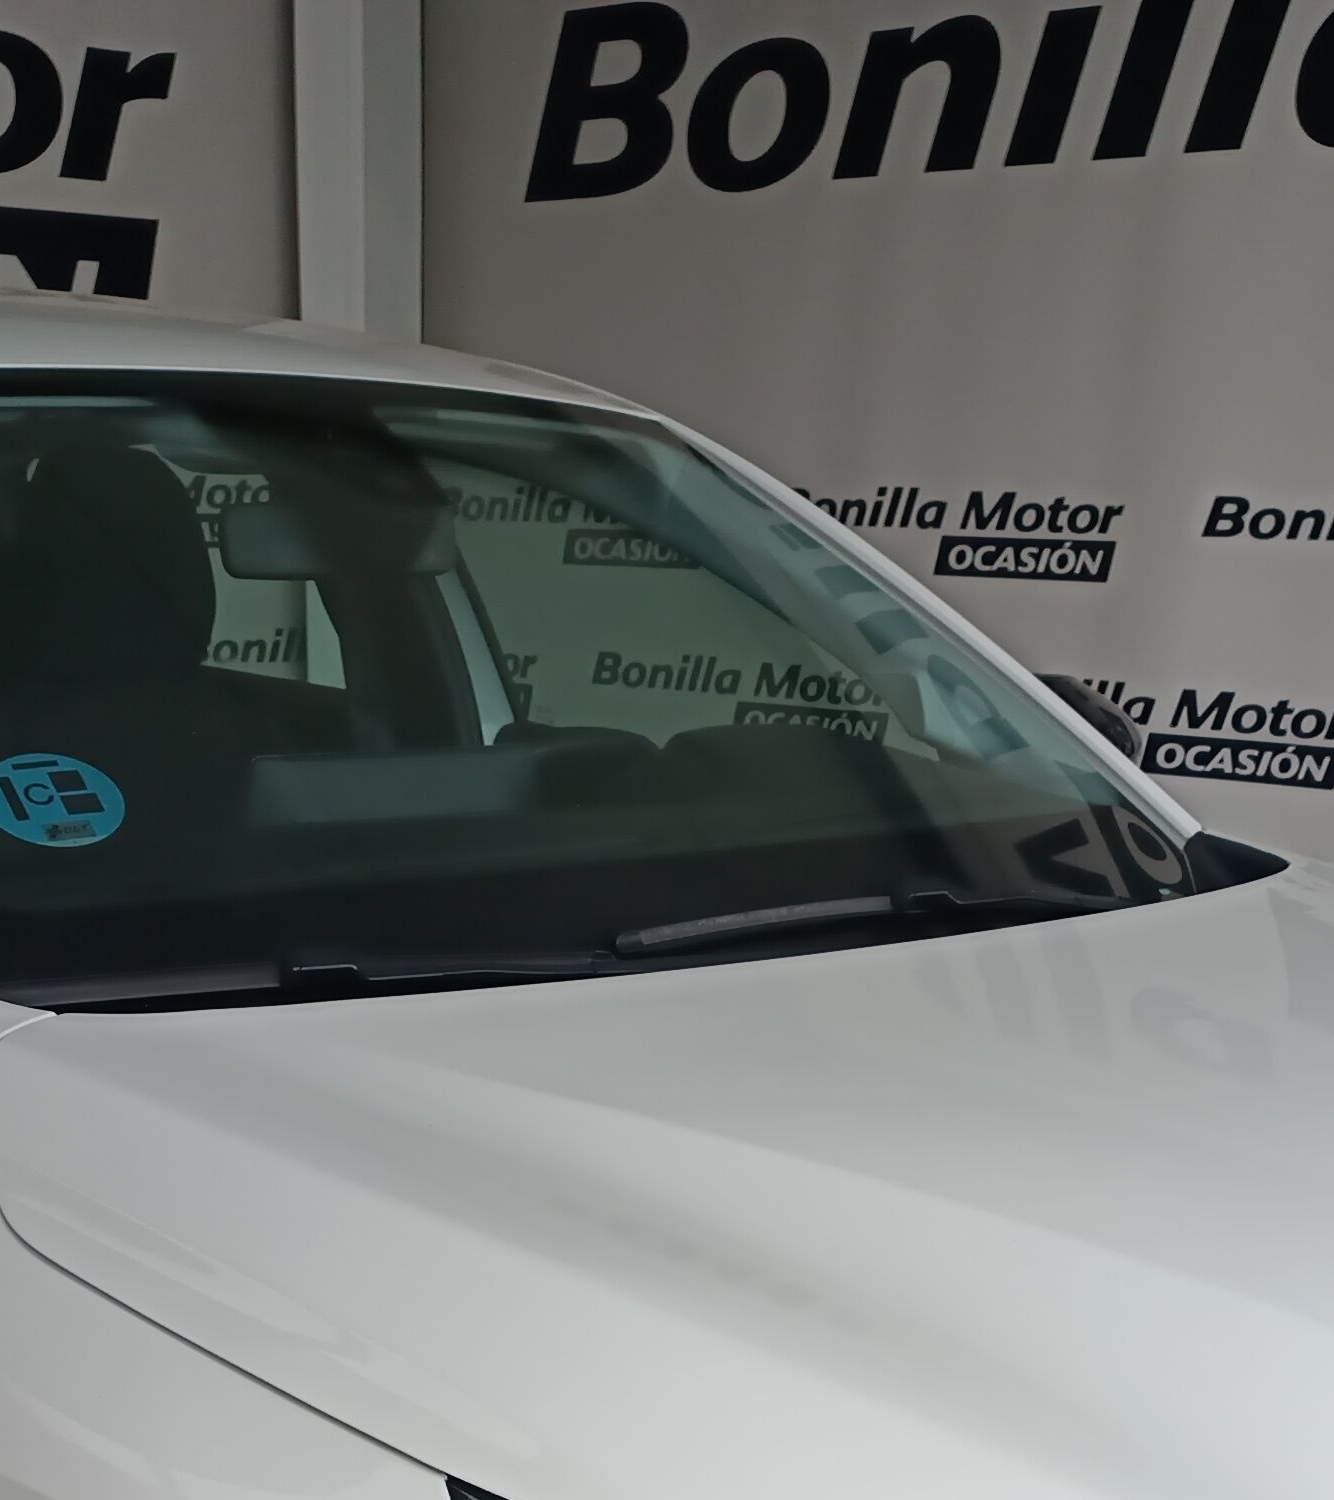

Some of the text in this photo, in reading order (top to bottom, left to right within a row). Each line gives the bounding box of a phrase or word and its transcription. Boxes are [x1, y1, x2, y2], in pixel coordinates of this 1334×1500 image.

[793, 486, 1124, 534] onilla Motor
[948, 541, 1104, 576] OCASIÓN
[592, 651, 742, 694] Bonilla
[1155, 743, 1332, 782] OCASIÓN
[23, 783, 55, 805] C
